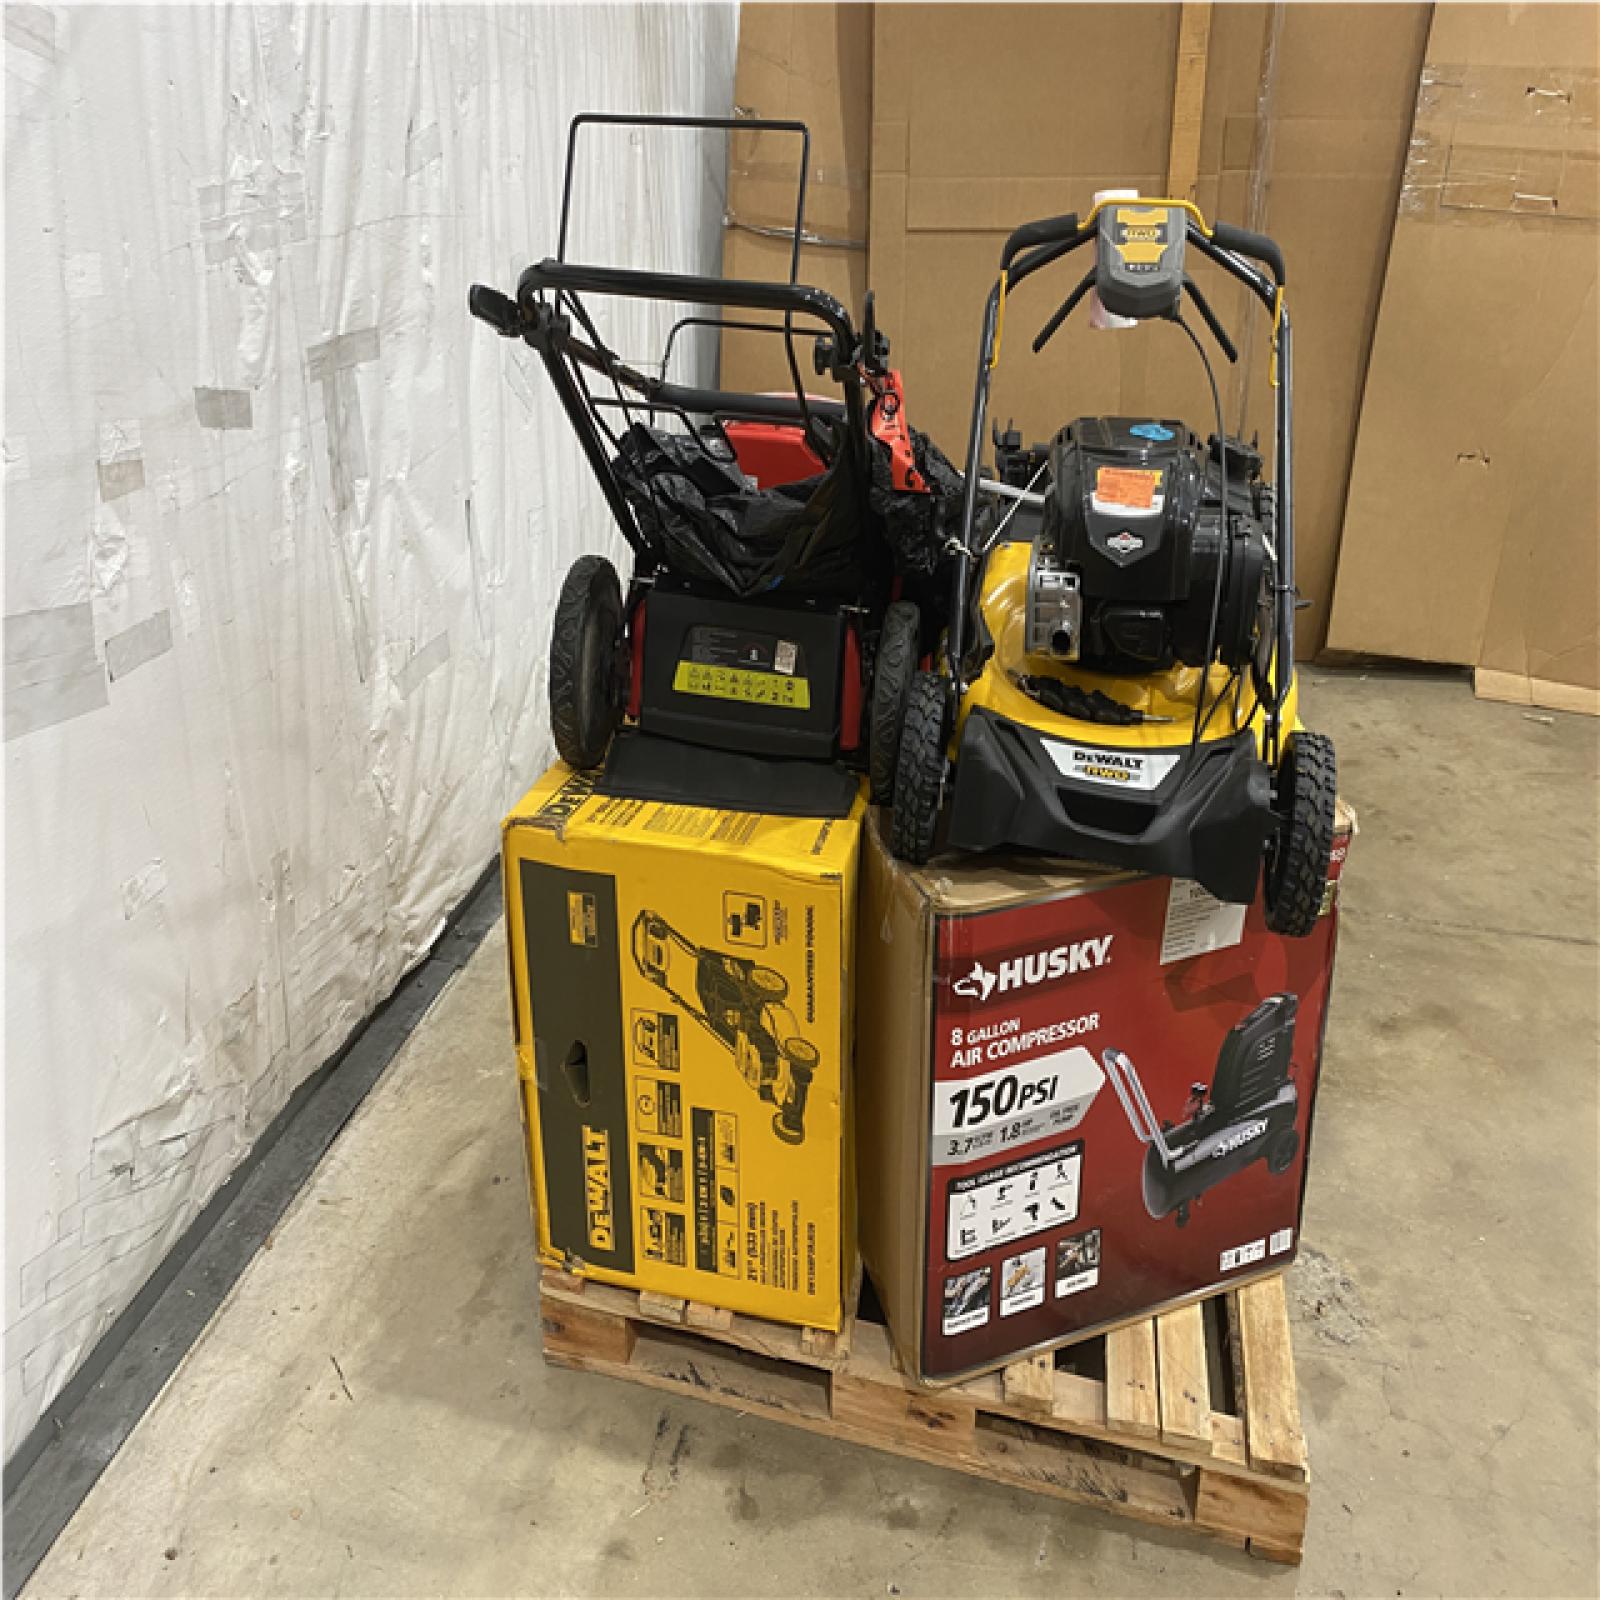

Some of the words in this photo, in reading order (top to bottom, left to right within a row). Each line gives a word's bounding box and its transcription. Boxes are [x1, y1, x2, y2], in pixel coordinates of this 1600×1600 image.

[998, 934, 1113, 992] HUSKY
[950, 1027, 963, 1046] 8
[966, 1016, 1021, 1045] GALLON
[950, 1046, 983, 1068] AIR
[986, 1012, 1101, 1061] COMPRESSOR
